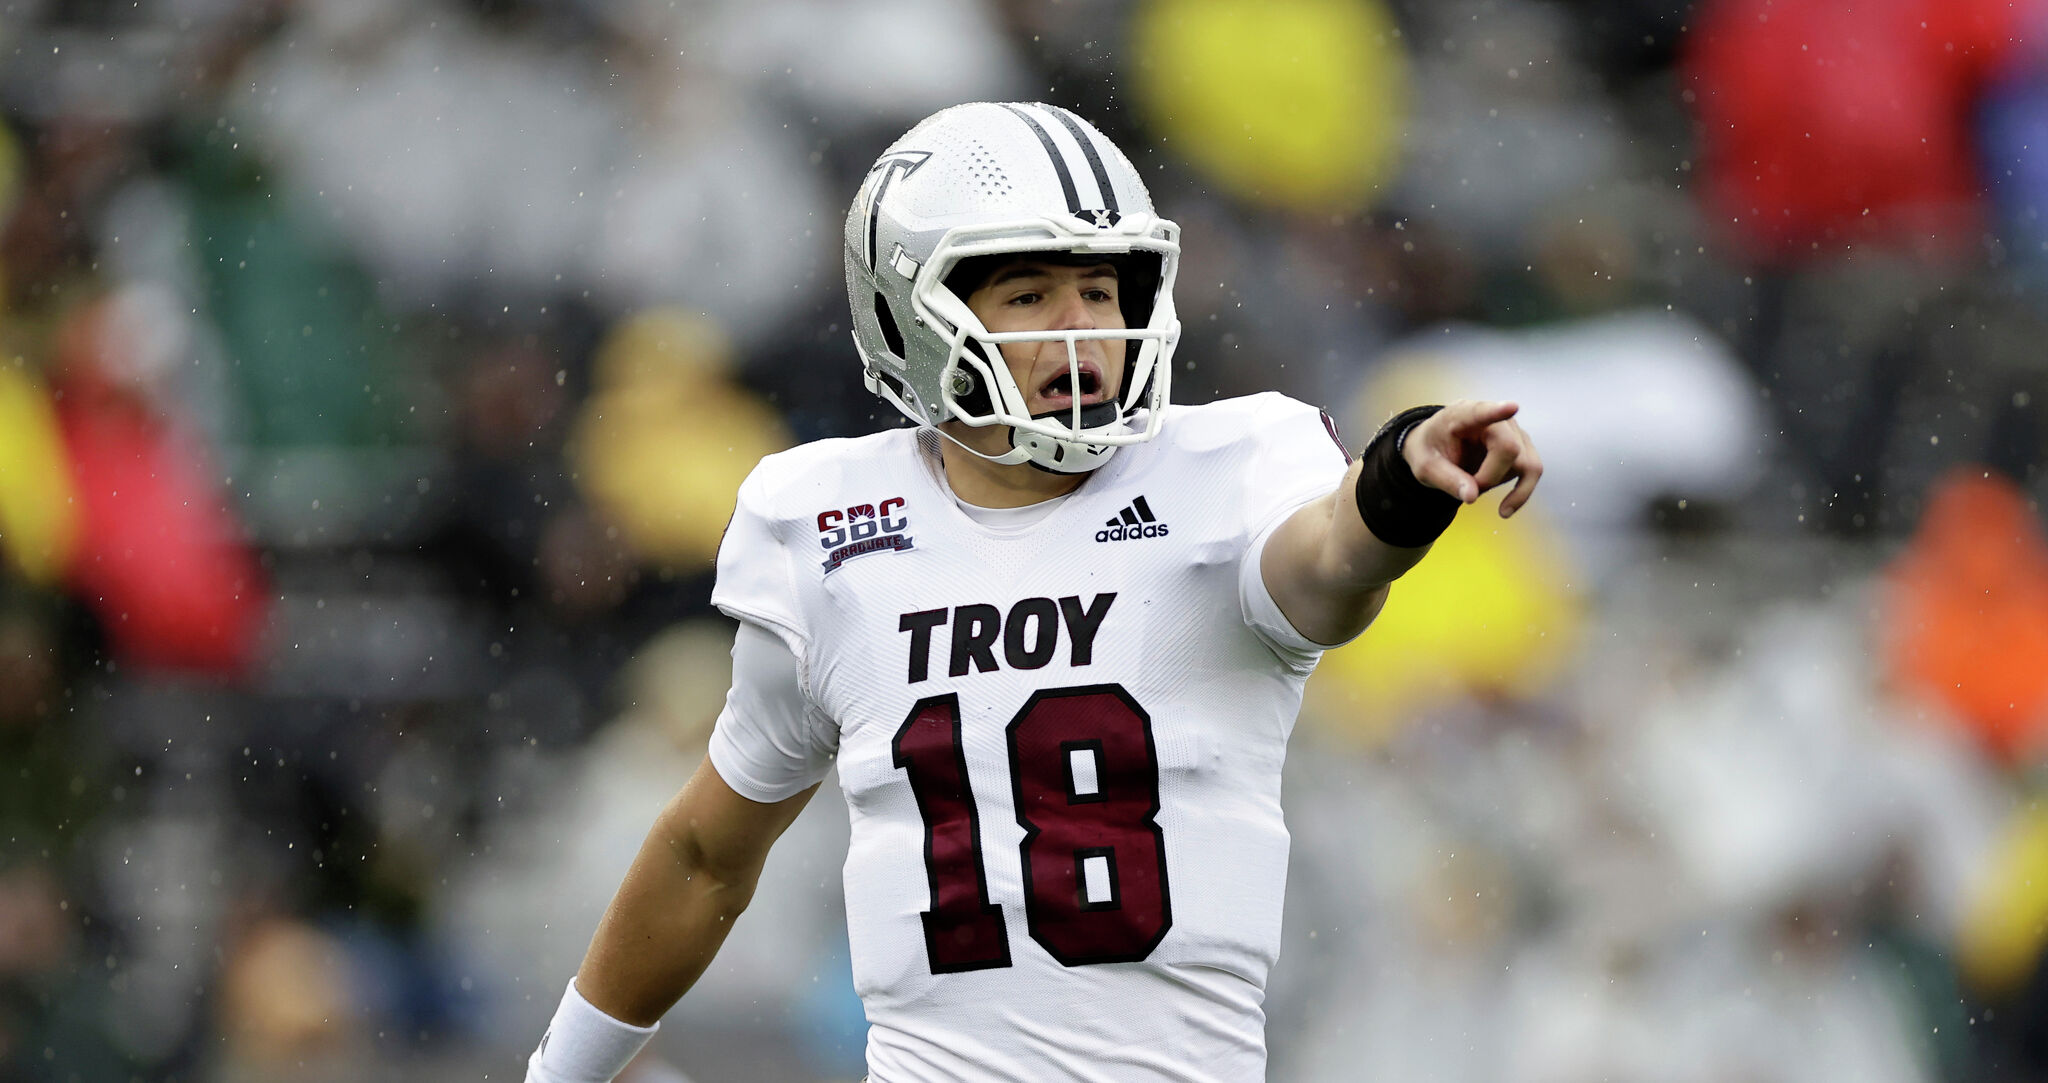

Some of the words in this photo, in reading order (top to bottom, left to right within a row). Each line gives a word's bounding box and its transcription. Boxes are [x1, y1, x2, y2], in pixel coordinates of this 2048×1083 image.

[817, 497, 907, 549] SBC
[831, 535, 902, 561] GRADUATE
[1095, 523, 1169, 542] adidas
[899, 592, 1117, 684] TROY
[892, 683, 1172, 975] 18
